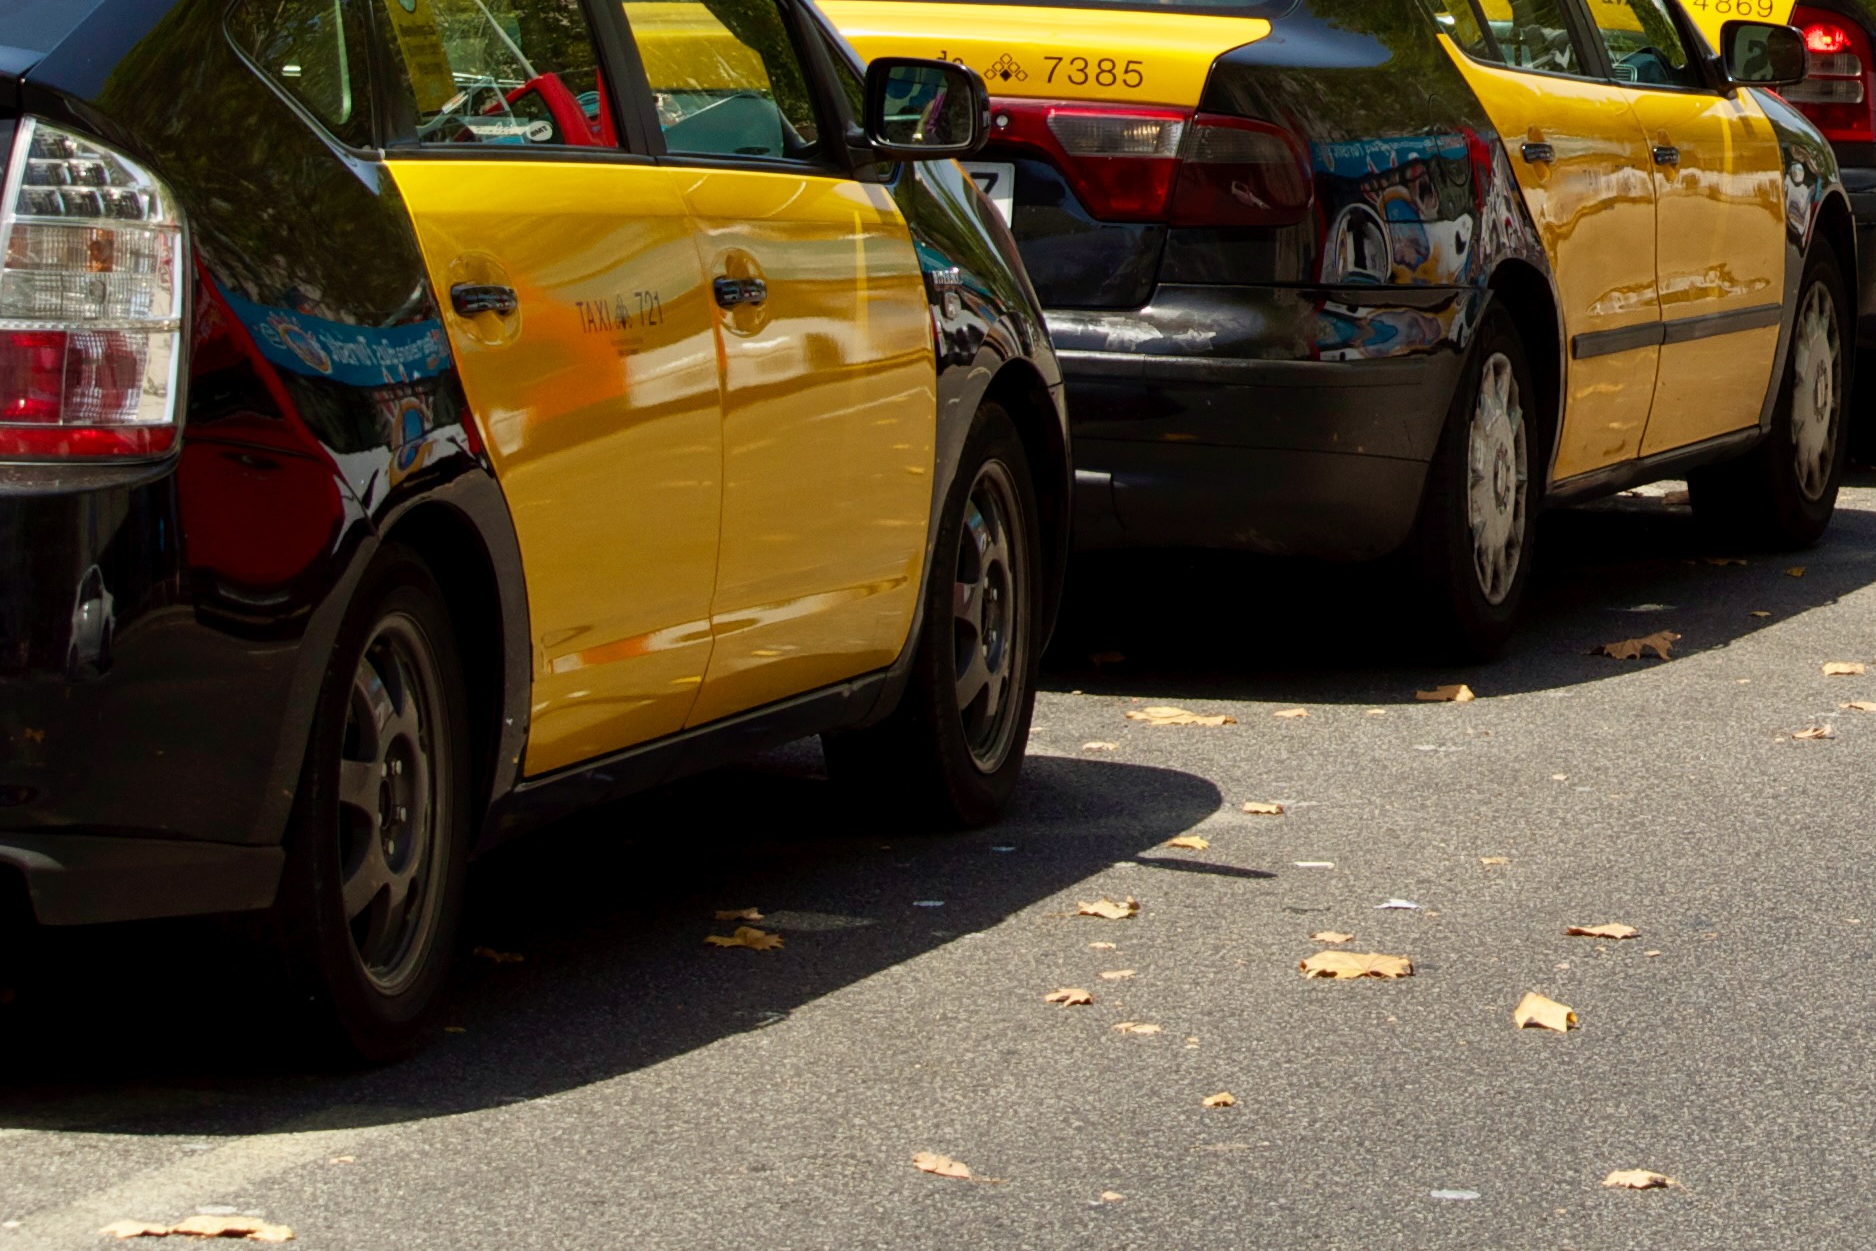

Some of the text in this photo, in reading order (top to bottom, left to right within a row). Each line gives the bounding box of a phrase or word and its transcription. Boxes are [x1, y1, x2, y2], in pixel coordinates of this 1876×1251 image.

[1044, 56, 1143, 87] 7385
[576, 292, 663, 333] TAXI 721
